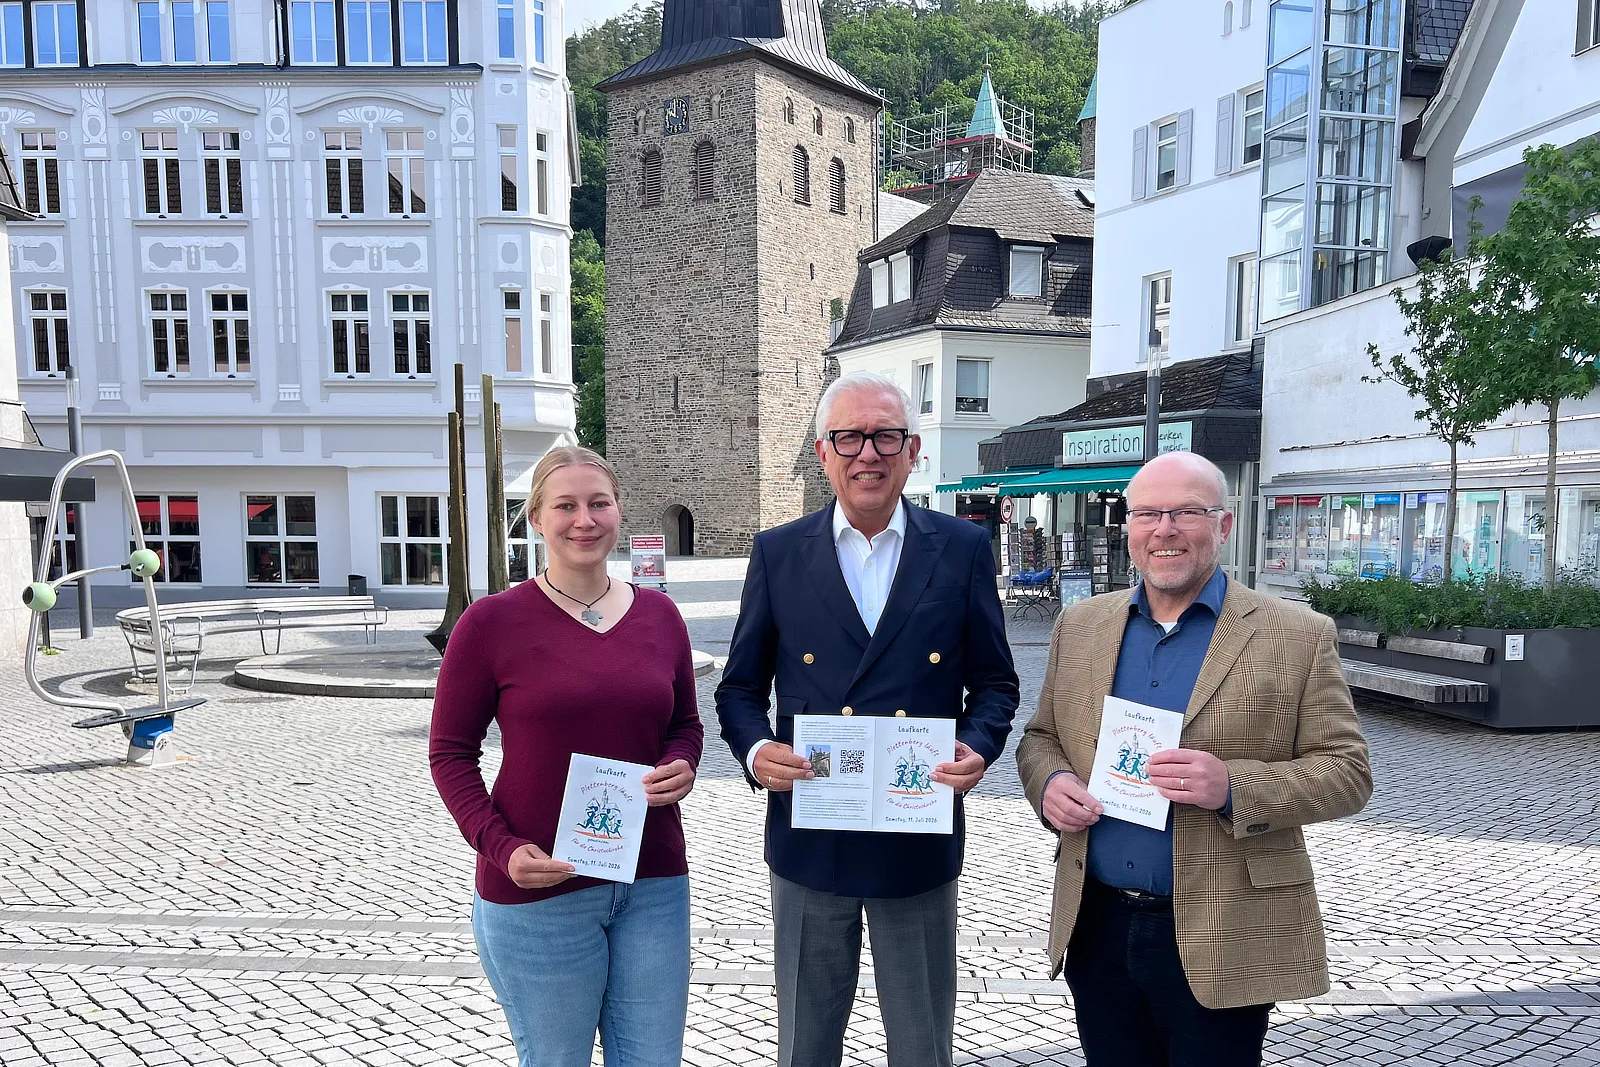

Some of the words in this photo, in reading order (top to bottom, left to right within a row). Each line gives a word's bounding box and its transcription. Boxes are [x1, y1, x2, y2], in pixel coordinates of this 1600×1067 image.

[1064, 433, 1140, 462] Inspiration
[1124, 710, 1155, 724] Laufkarte
[898, 725, 930, 734] Laufkarte
[1112, 725, 1147, 738] Plettenberg
[886, 738, 923, 755] Plettenberg
[924, 742, 940, 757] läuft
[595, 766, 627, 778] Laufkarte
[580, 780, 619, 795] Plettenberg
[619, 786, 633, 802] läuft
[1139, 808, 1152, 816] 2026
[587, 845, 624, 854] Christuskirche
[607, 862, 621, 870] 2026
